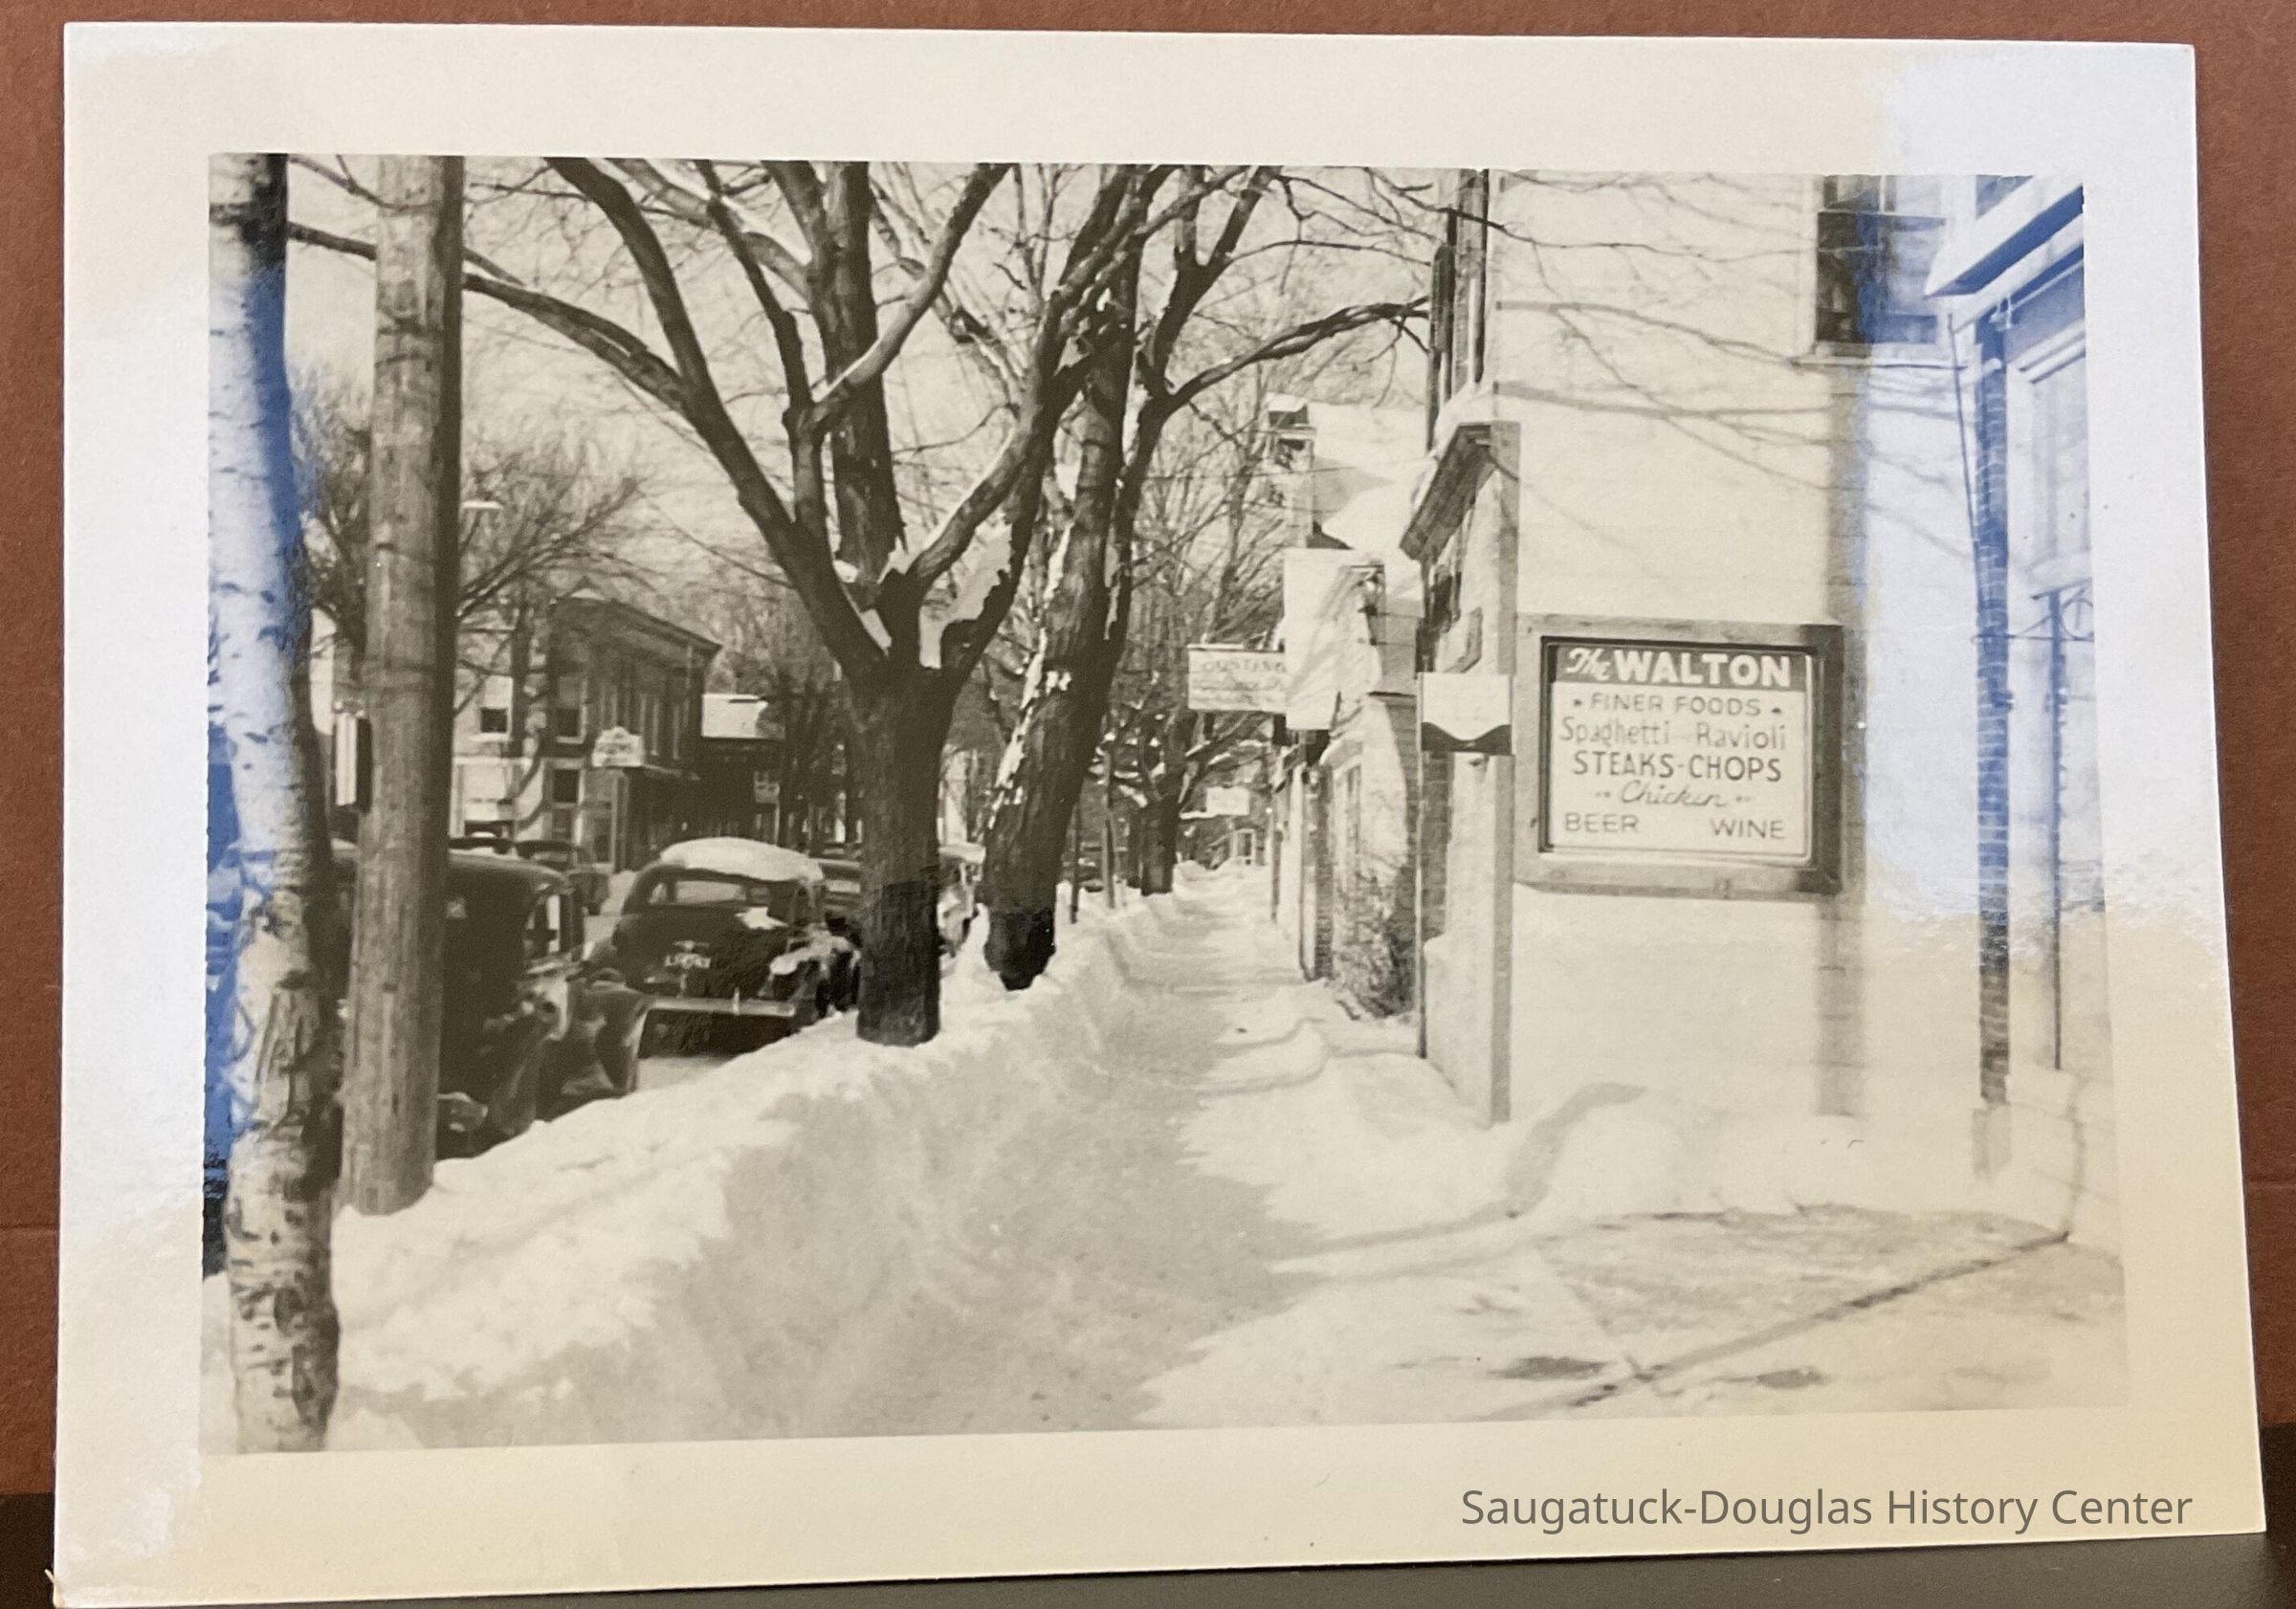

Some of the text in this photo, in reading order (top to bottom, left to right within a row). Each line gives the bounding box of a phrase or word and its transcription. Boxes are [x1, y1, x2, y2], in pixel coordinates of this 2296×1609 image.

[1566, 648, 1791, 688] The WALTON
[1591, 692, 1762, 717] FINER FOODS
[1559, 716, 1787, 751] Spaghetti Ravioli
[1621, 779, 1729, 808] Chicken
[1564, 812, 1786, 840] BEER WINE
